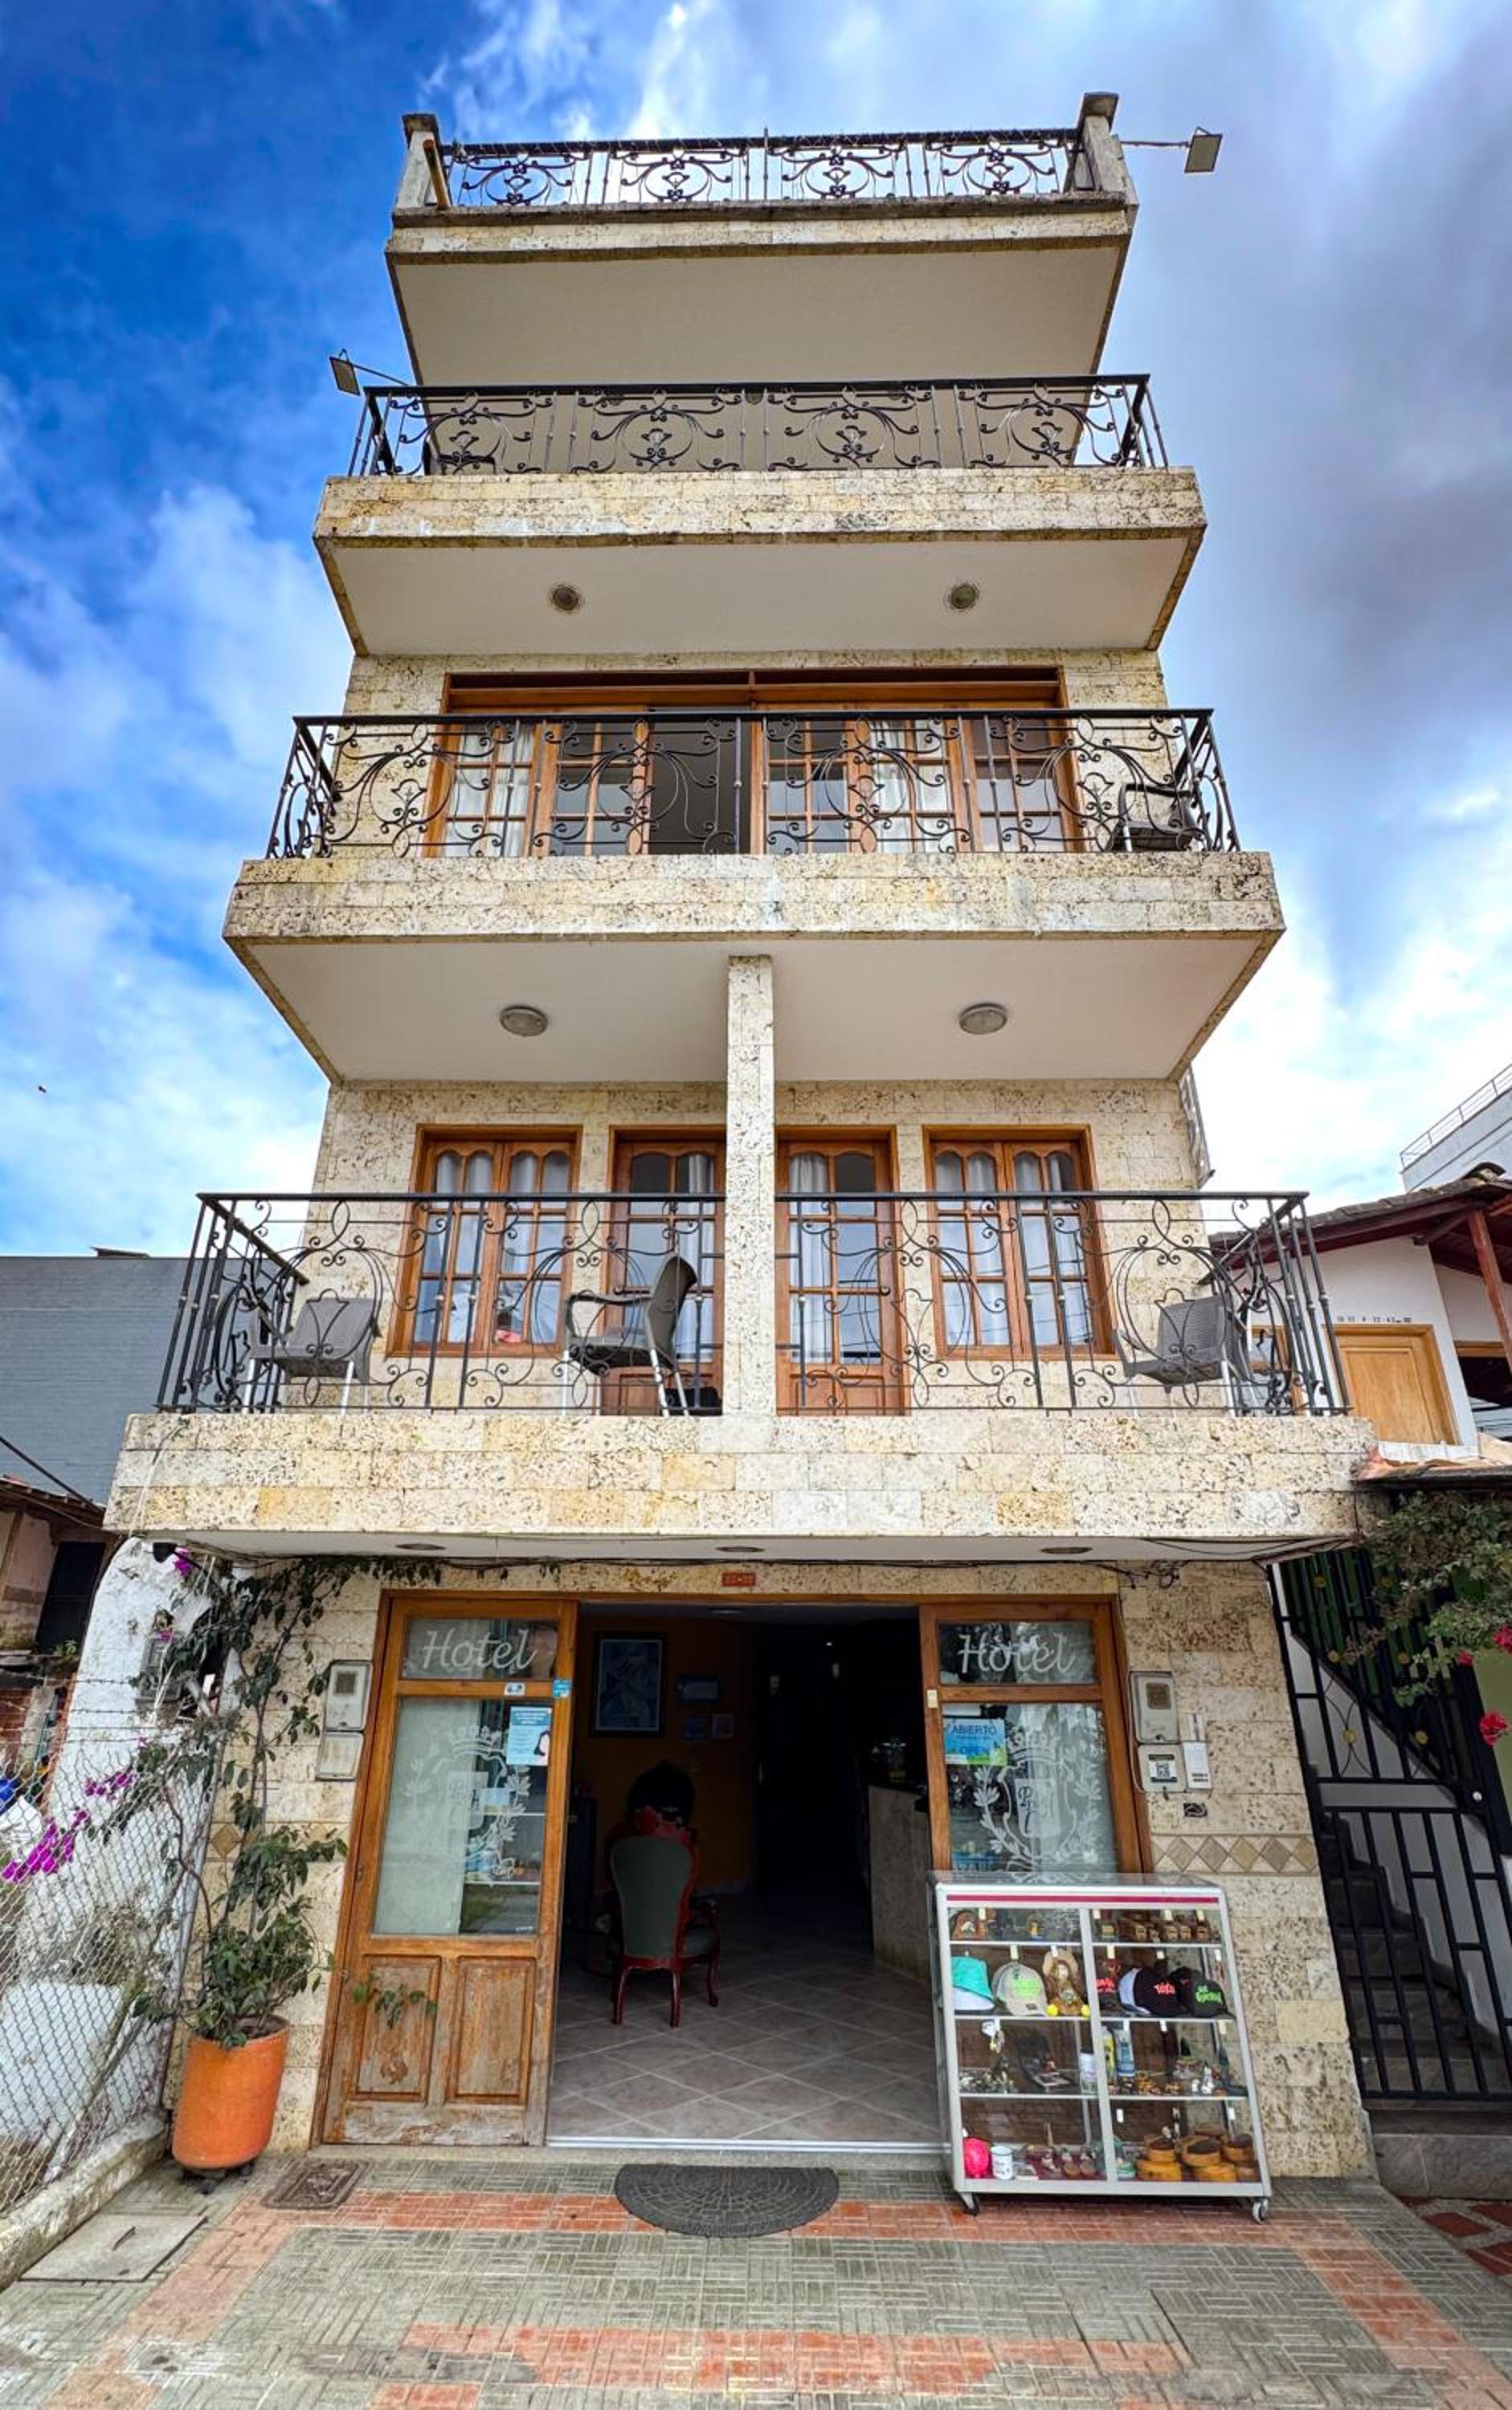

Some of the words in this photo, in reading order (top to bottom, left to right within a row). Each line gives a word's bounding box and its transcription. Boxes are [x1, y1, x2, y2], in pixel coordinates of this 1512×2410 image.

[423, 1628, 538, 1669] Hotel
[958, 1632, 1075, 1673] Hotel
[951, 1725, 997, 1735] ABIERTO
